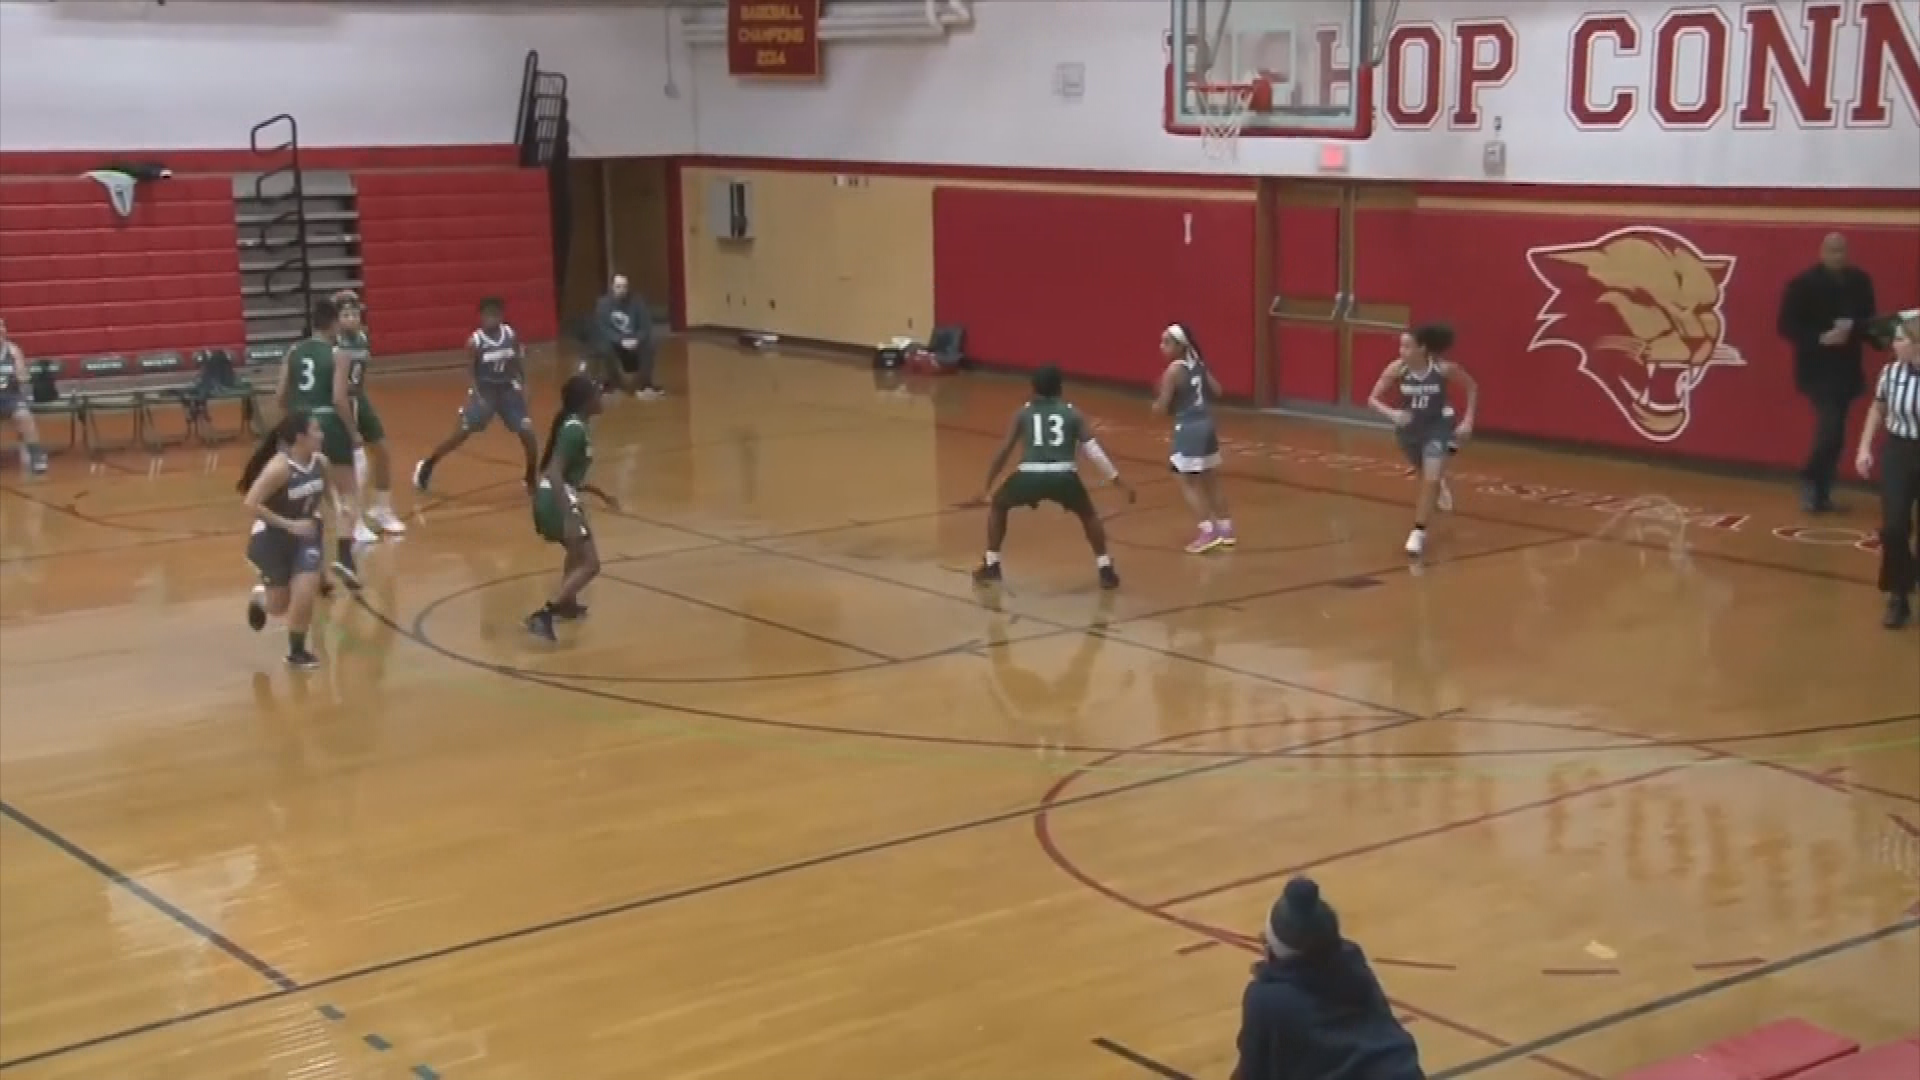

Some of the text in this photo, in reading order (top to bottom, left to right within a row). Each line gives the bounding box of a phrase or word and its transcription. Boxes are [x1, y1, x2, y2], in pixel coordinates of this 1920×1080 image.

[738, 27, 805, 43] CHAMPIONS
[298, 357, 315, 391] 3
[1033, 413, 1065, 447] 13
